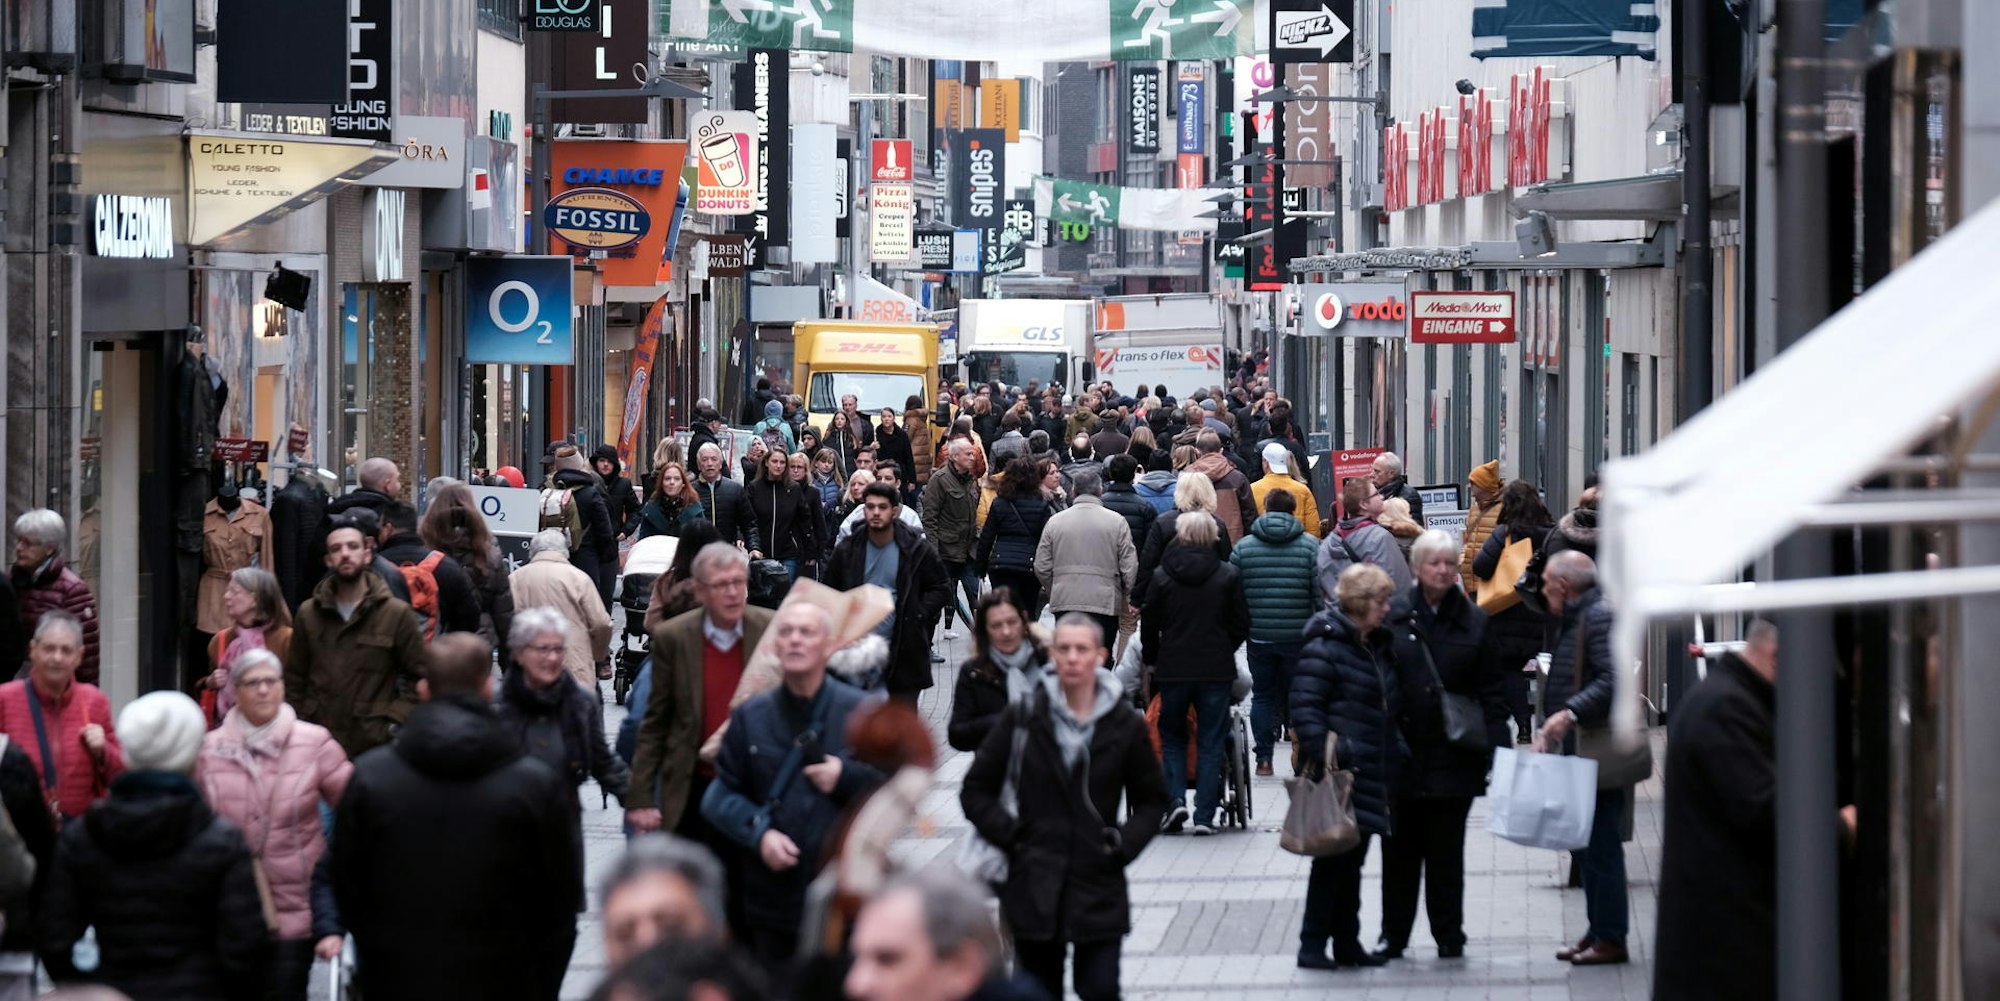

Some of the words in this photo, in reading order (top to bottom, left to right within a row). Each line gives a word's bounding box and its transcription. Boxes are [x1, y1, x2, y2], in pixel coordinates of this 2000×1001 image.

[536, 16, 591, 28] DOUGLAS
[1183, 64, 1200, 74] dm
[754, 52, 769, 142] TRAINERS
[1149, 75, 1157, 121] MONDE
[1182, 83, 1198, 101] 73
[334, 100, 386, 114] OUNG
[1133, 74, 1146, 147] MAISONS
[246, 113, 273, 133] LEDER
[276, 115, 283, 133] &
[285, 115, 327, 135] TEXTILIEN
[331, 116, 392, 131] SHION
[1149, 131, 1157, 147] DU
[200, 142, 284, 156] CALETTO
[401, 145, 449, 160] ORA
[211, 164, 241, 172] YOUNG
[245, 164, 281, 172] FASHION
[719, 160, 734, 171] DD
[563, 168, 665, 186] CHANGE
[969, 149, 998, 217] snipes
[698, 188, 753, 198] DUNKIN'
[876, 187, 907, 196] Pizza
[565, 195, 632, 210] AUTHENTIC
[698, 199, 749, 209] DONUTS
[875, 199, 909, 210] König
[95, 193, 174, 259] CALZEDONIA
[555, 208, 641, 232] FOSSIL
[376, 187, 405, 283] ONLY
[917, 235, 950, 245] LUSH
[709, 243, 743, 254] LBEN
[707, 256, 741, 267] WALD
[863, 300, 906, 313] FOOD
[1022, 326, 1063, 341] GLS
[1422, 320, 1483, 334] EINGANG
[837, 343, 900, 354] DHL
[1429, 518, 1467, 528] Samsun
